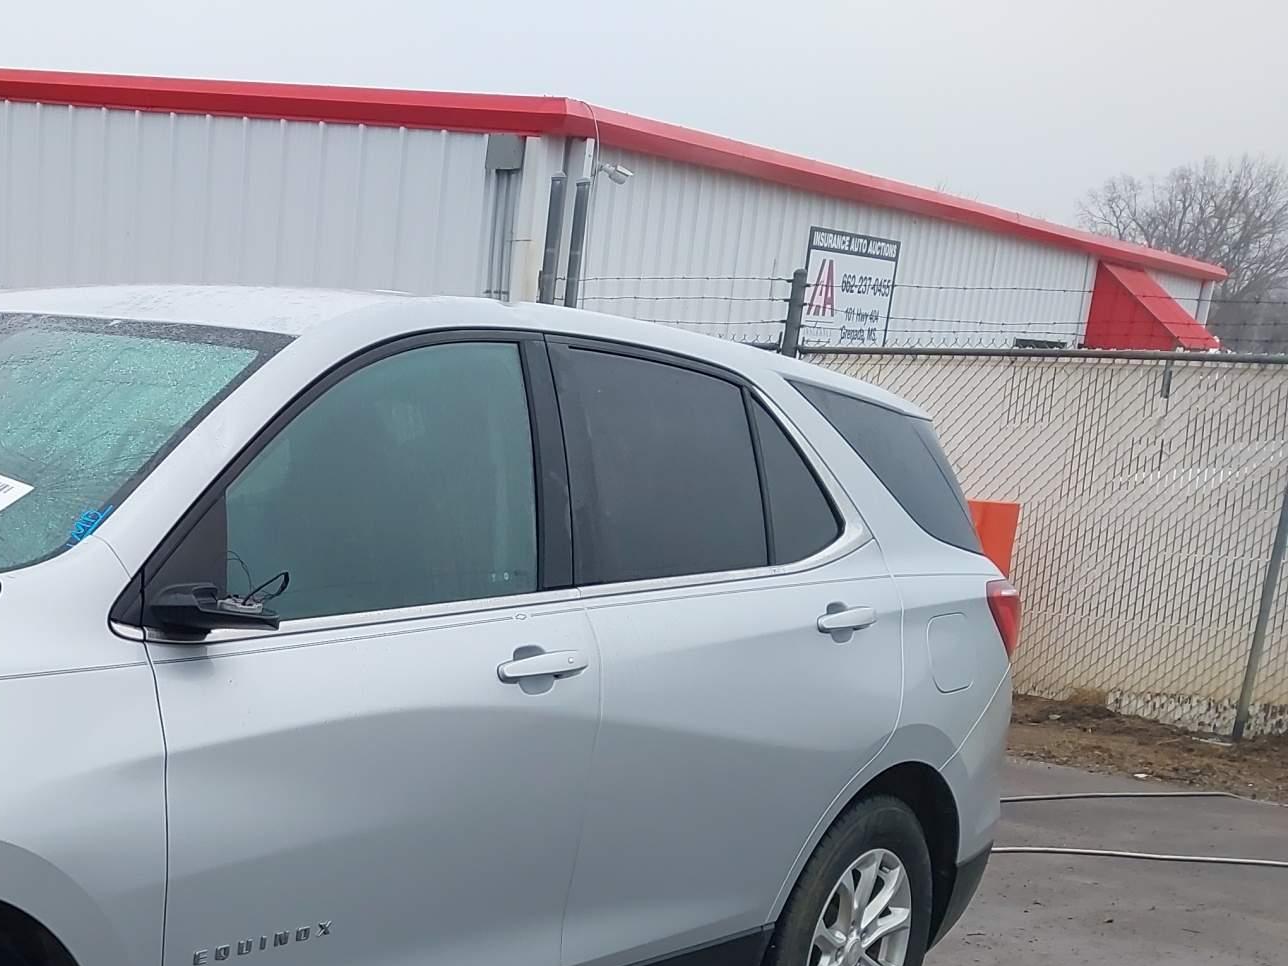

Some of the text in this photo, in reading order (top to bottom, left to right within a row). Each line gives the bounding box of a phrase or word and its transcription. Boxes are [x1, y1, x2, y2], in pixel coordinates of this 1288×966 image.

[813, 231, 898, 258] INSURANCE AUTO AUCTIONS
[841, 273, 892, 297] 662-237-0455
[845, 307, 856, 322] 101
[856, 307, 869, 326] Hwy
[192, 920, 333, 966] EQUINOX
